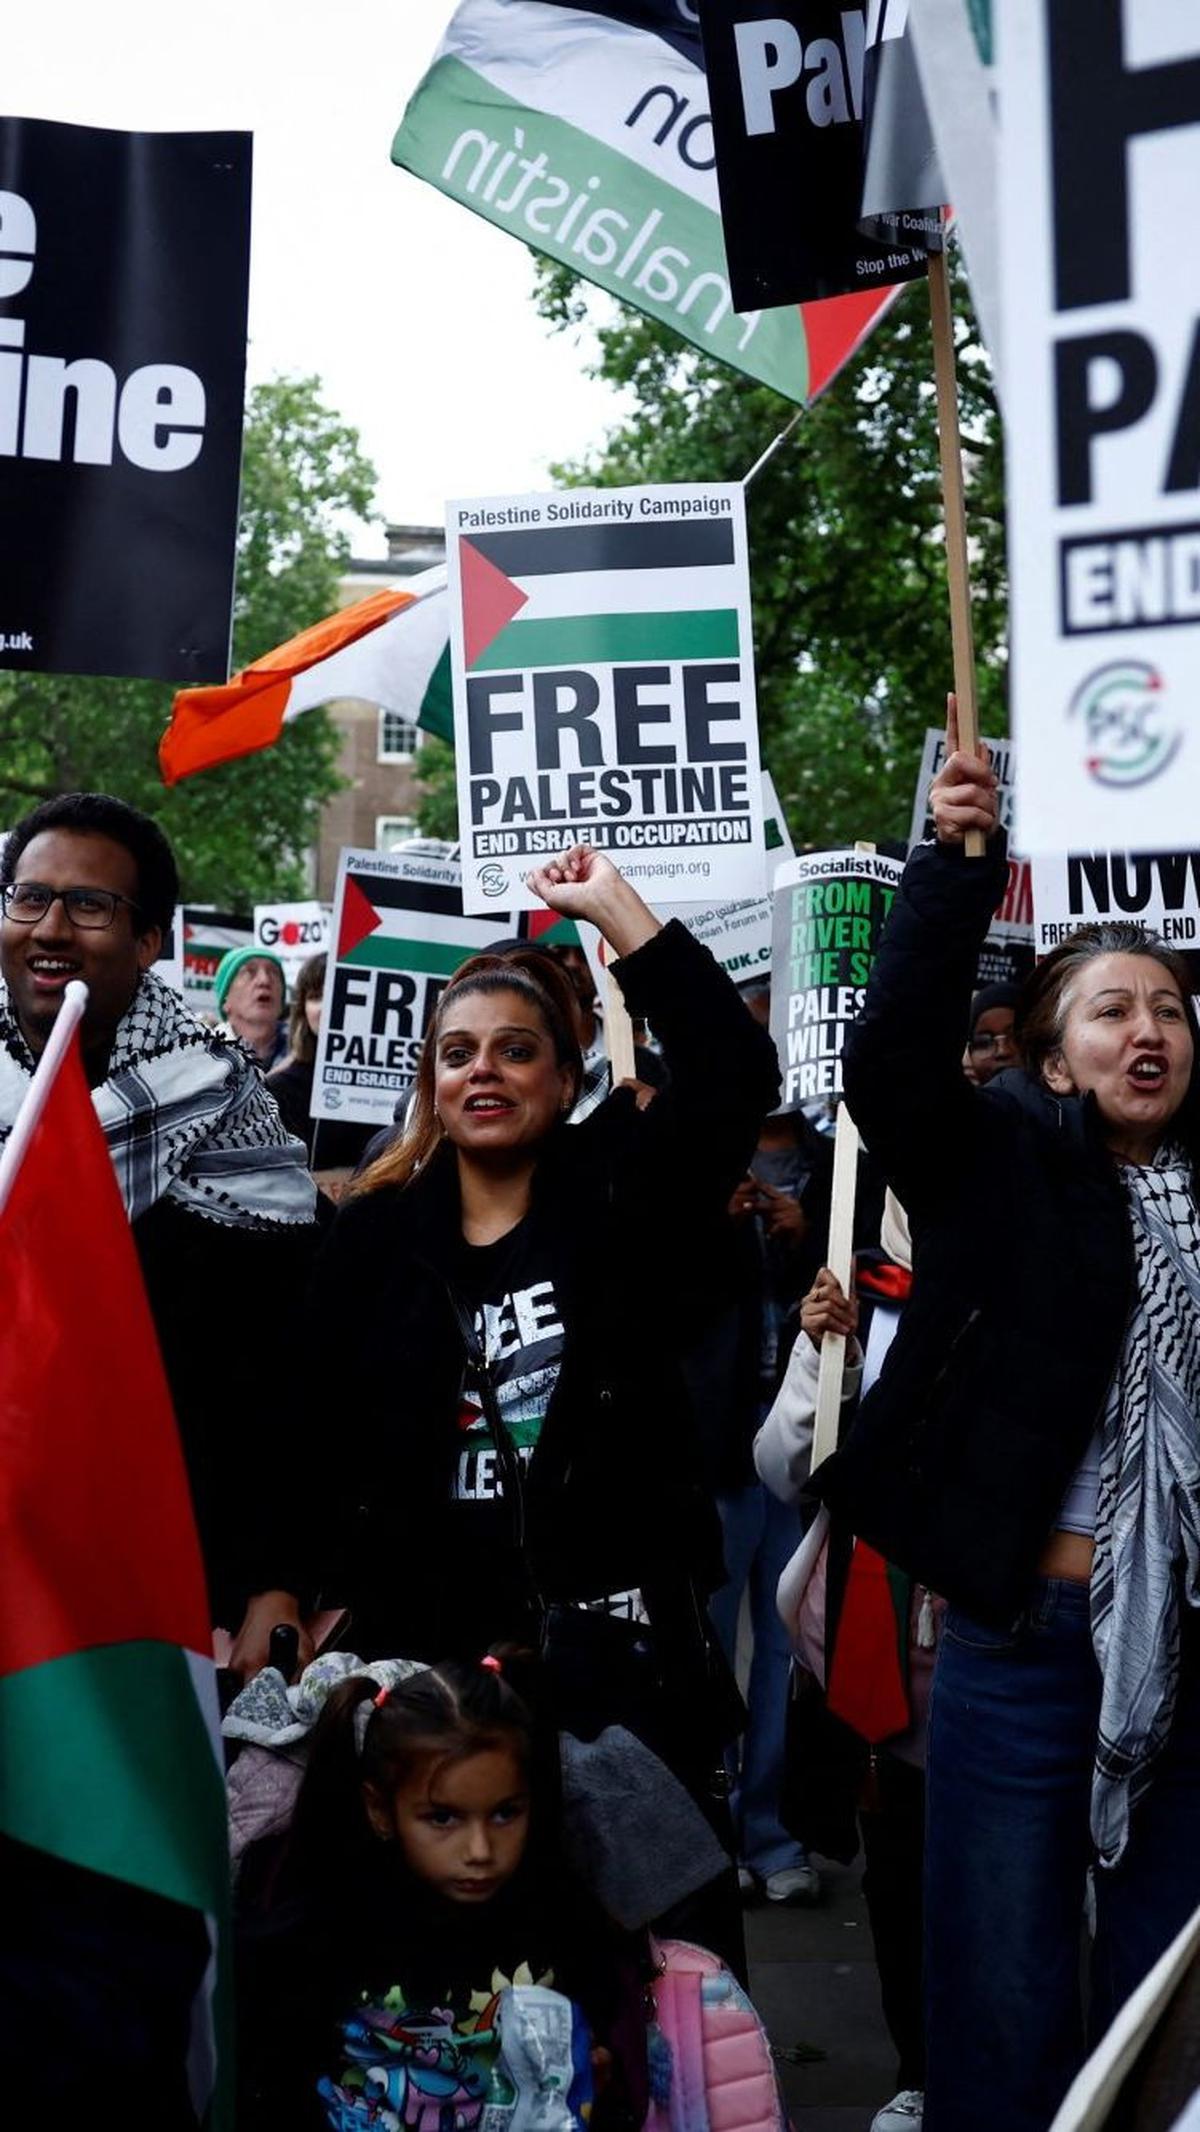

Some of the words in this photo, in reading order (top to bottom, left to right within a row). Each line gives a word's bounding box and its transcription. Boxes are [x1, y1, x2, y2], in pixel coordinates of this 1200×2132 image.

[856, 259, 885, 276] Stop
[888, 253, 911, 269] the
[458, 506, 540, 527] Palestine
[547, 499, 633, 521] Solidarity
[640, 497, 732, 517] Campaign
[466, 663, 748, 776] FREE
[470, 765, 750, 826] PALESTINE
[475, 832, 519, 857] END
[525, 826, 609, 852] ISRAELI
[615, 820, 749, 847] OCCUPATION
[346, 856, 399, 874] Palestine
[403, 863, 456, 883] Solidarity
[800, 857, 871, 878] Socialist
[791, 881, 871, 922] FROM
[791, 917, 871, 956] RIVER
[1163, 917, 1196, 940] END
[790, 951, 841, 993] THE
[325, 1067, 353, 1085] END
[356, 1071, 408, 1090] ISRAELI
